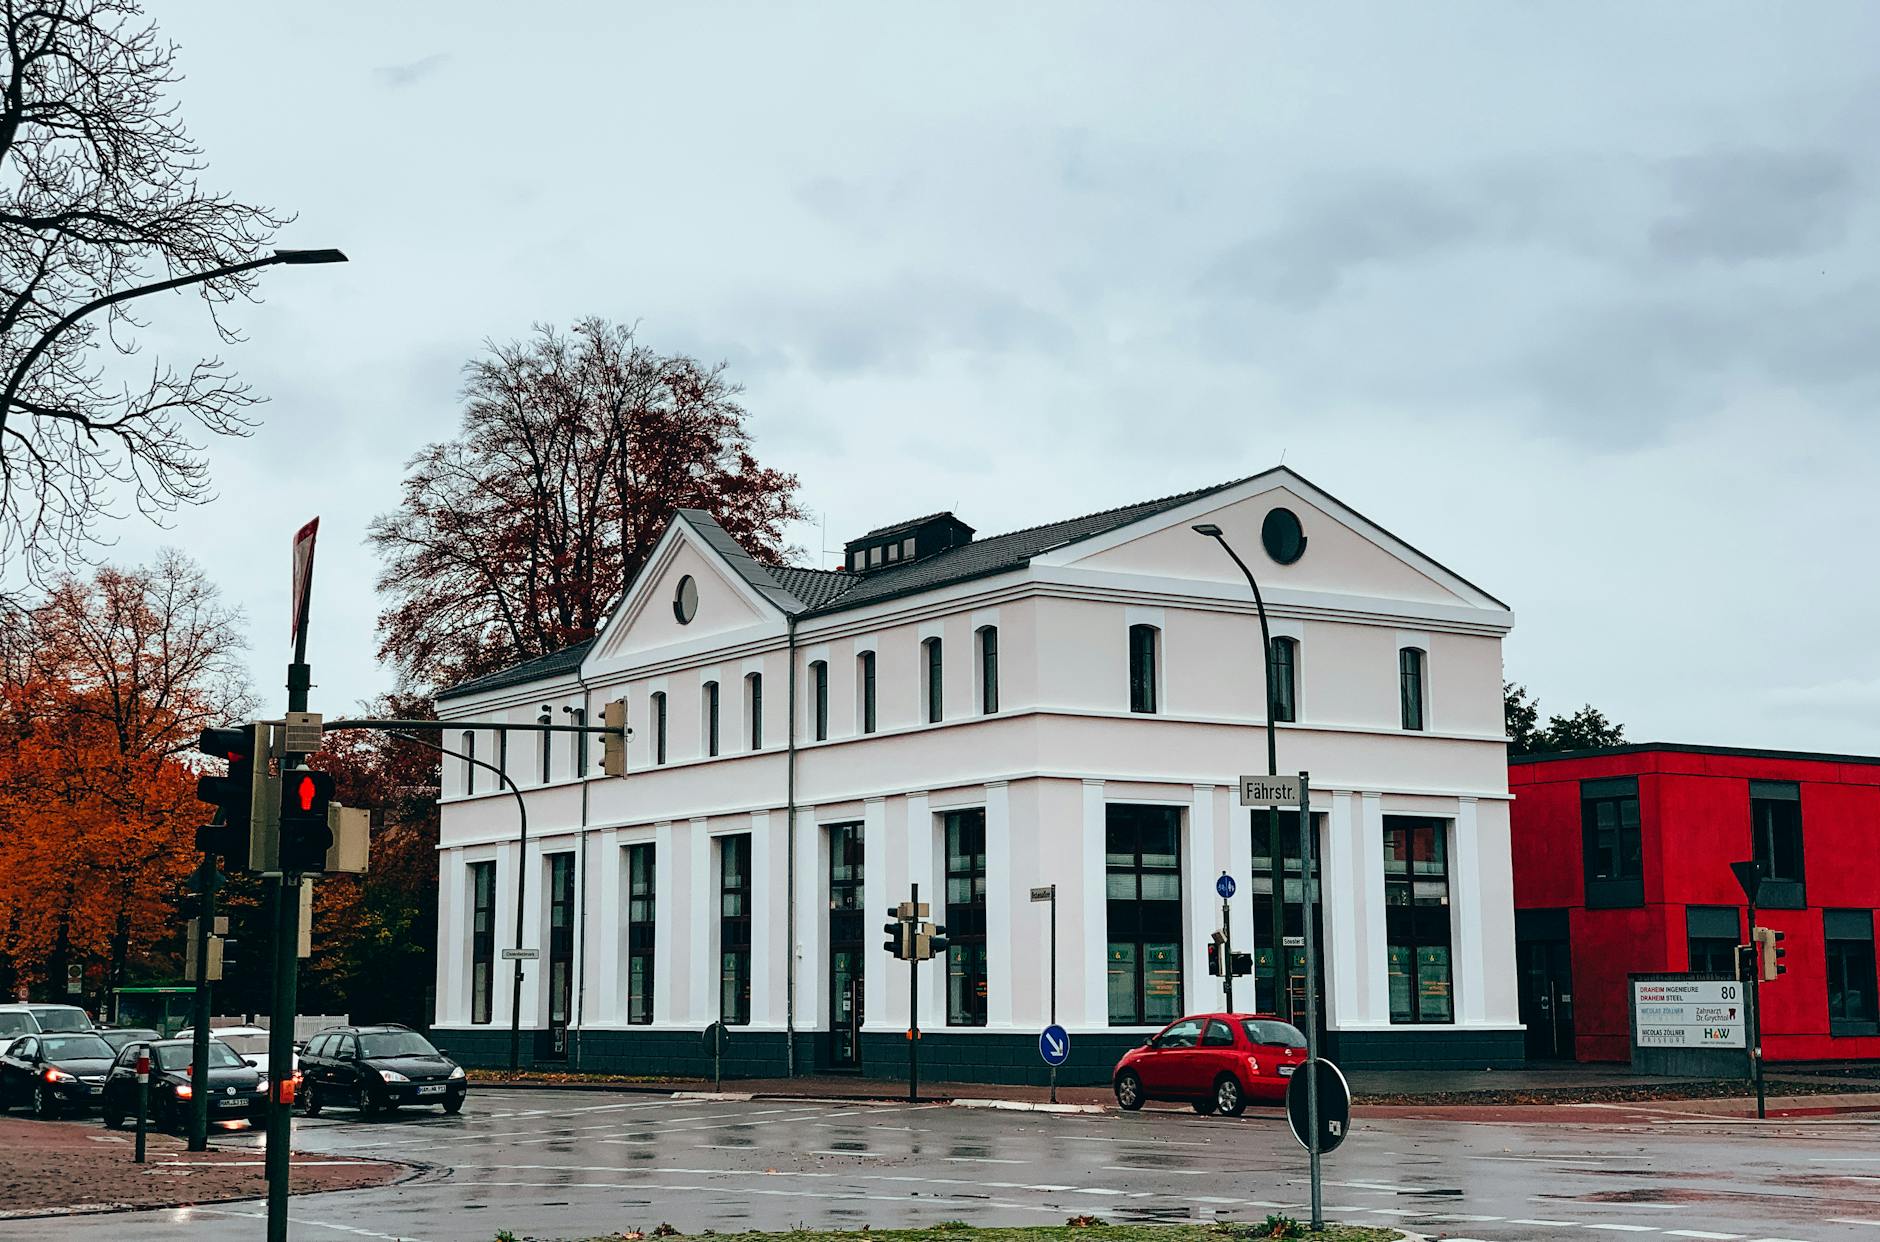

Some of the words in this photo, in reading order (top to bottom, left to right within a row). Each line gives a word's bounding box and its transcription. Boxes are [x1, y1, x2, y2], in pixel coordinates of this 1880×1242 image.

[1246, 782, 1295, 800] Fährstr.
[1721, 987, 1736, 1000] 80
[1704, 1028, 1730, 1039] H&W
[1642, 1036, 1685, 1044] FRISEURE
